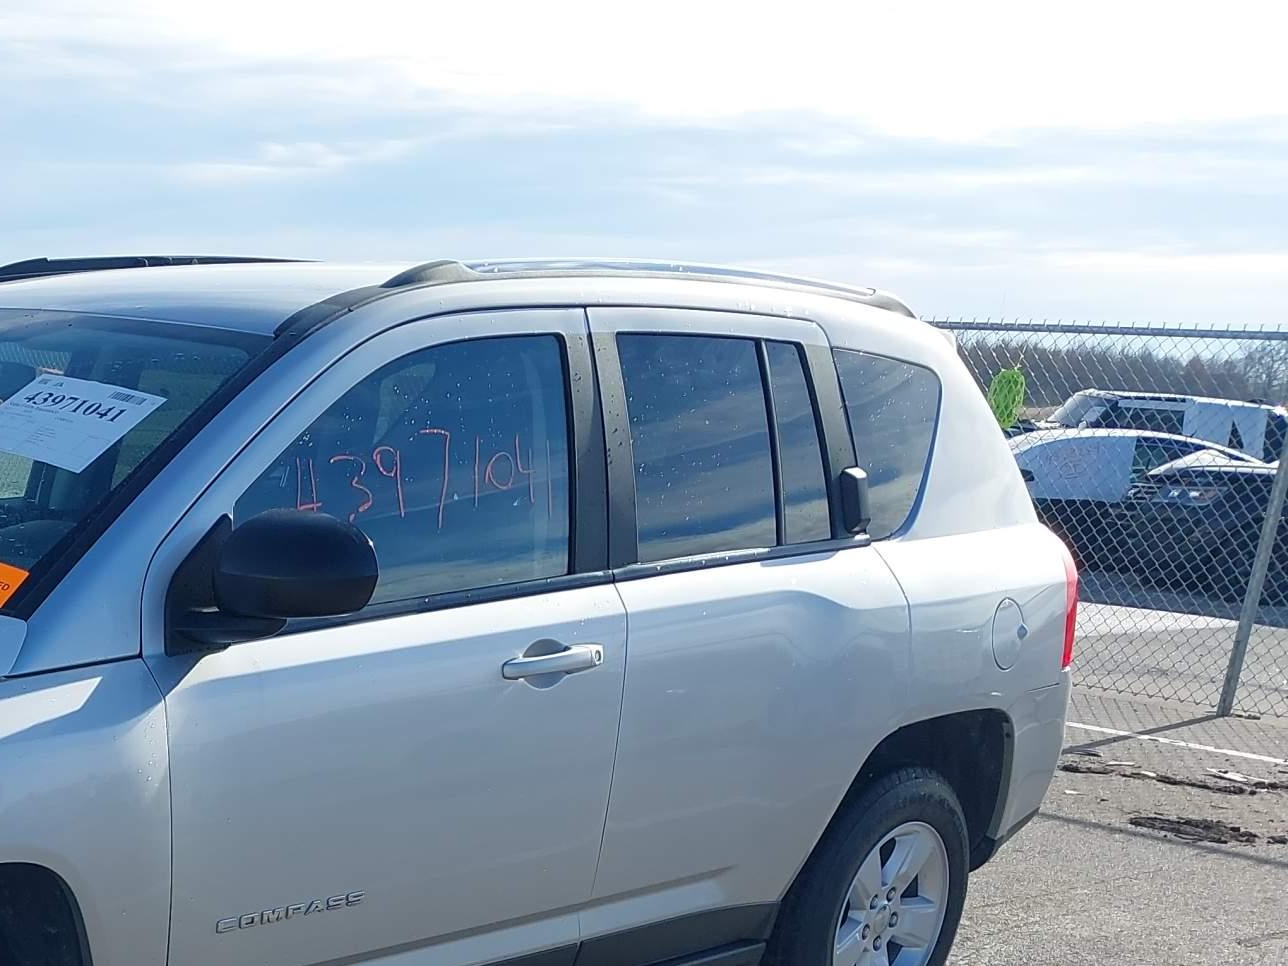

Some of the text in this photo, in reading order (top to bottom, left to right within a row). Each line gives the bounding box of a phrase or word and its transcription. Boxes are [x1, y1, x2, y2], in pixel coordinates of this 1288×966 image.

[23, 391, 128, 423] 43971041
[296, 428, 553, 530] 43971041
[215, 890, 366, 934] COMPASS
